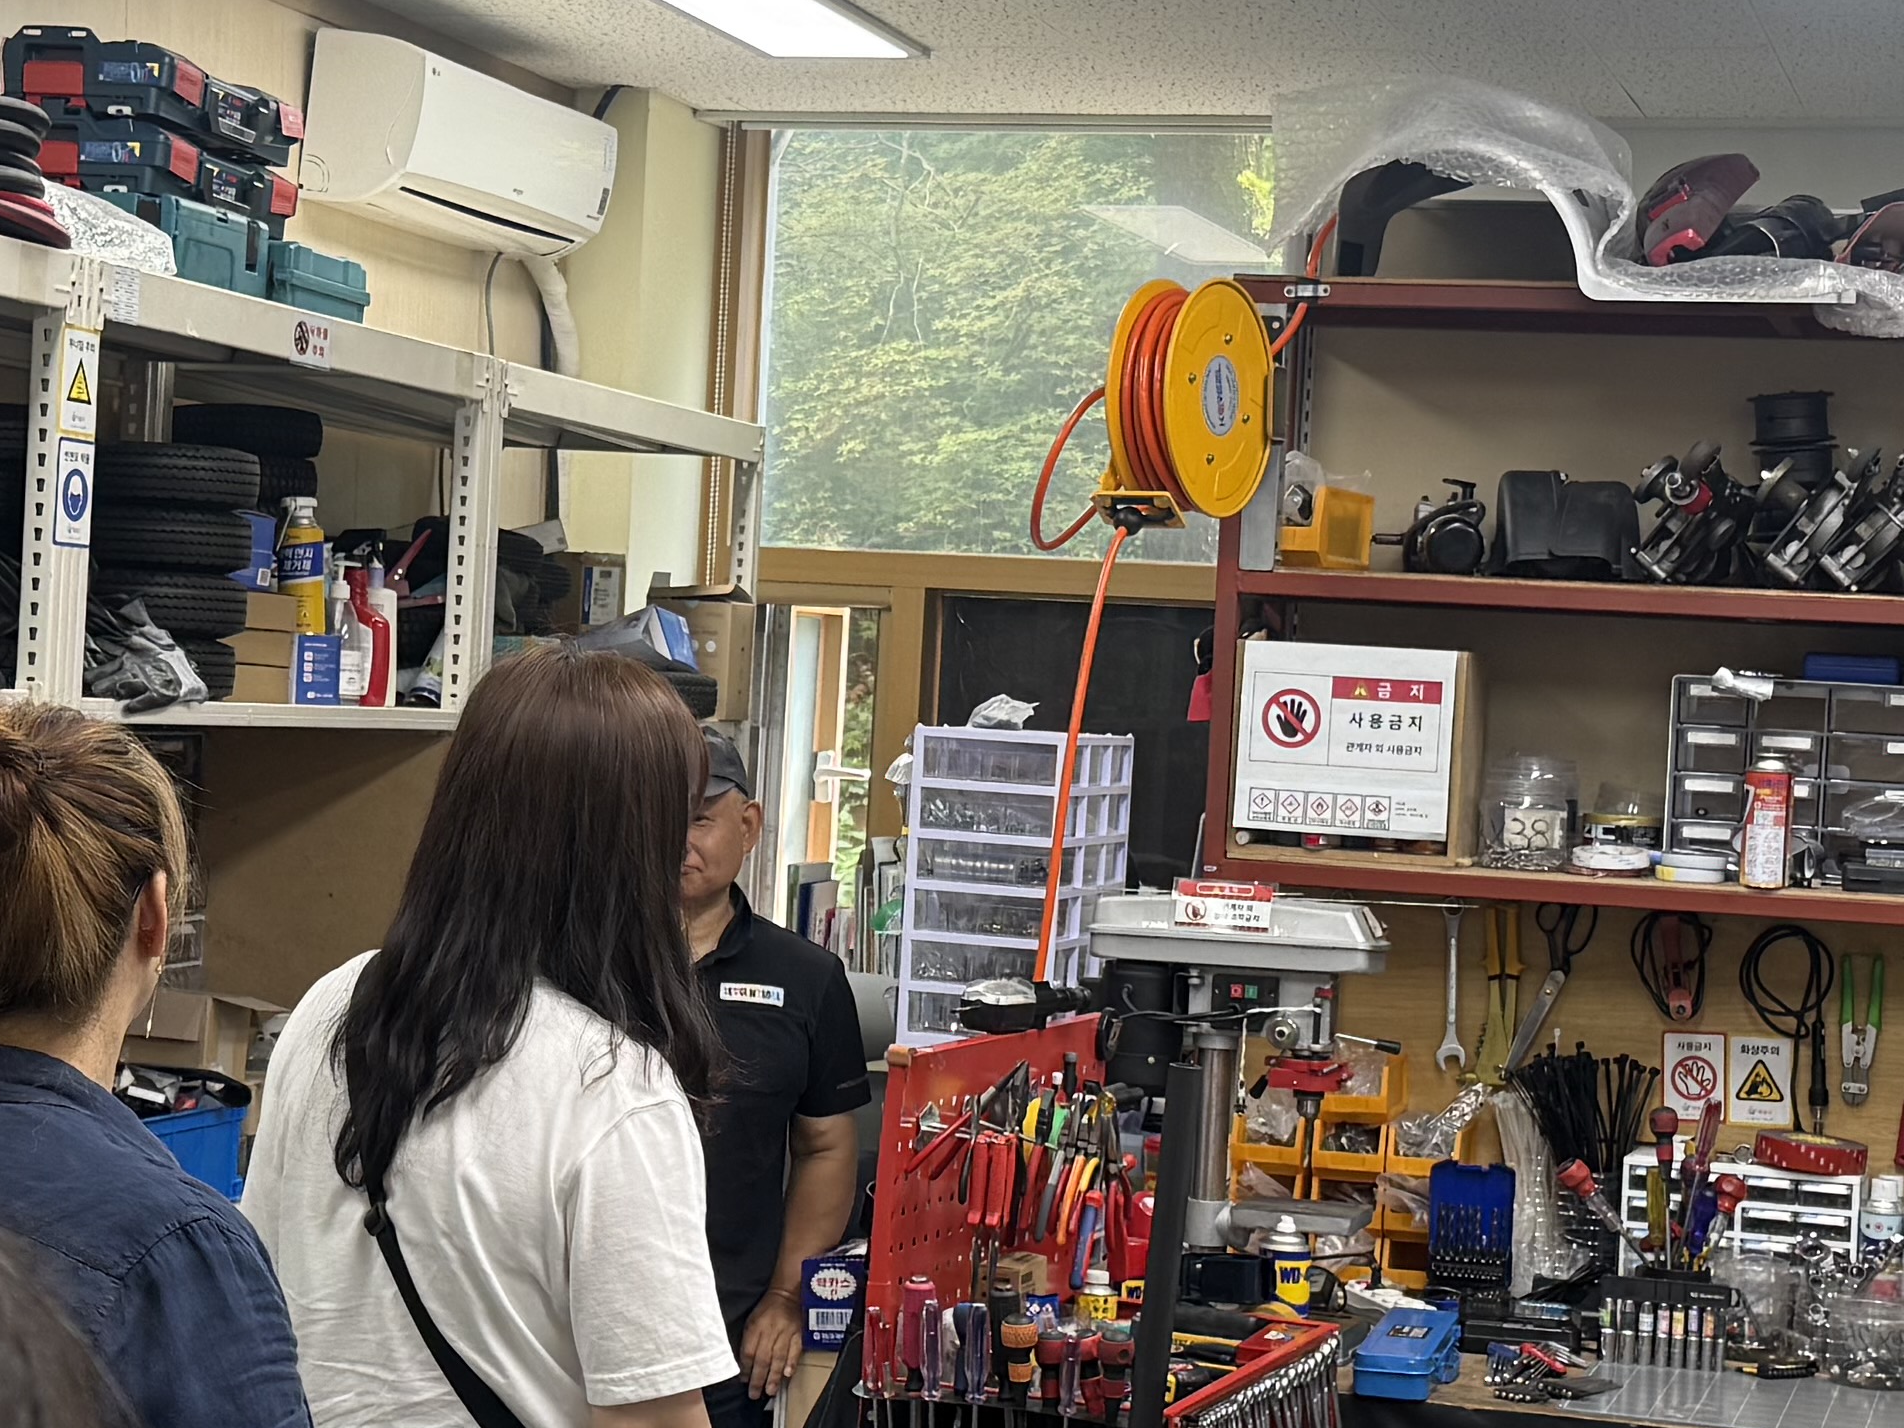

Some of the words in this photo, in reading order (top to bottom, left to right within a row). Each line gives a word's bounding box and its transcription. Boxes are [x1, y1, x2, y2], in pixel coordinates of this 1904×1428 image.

[1349, 712, 1423, 732] 사용금지
[1387, 745, 1423, 756] 사용금지
[1509, 817, 1550, 851] 38
